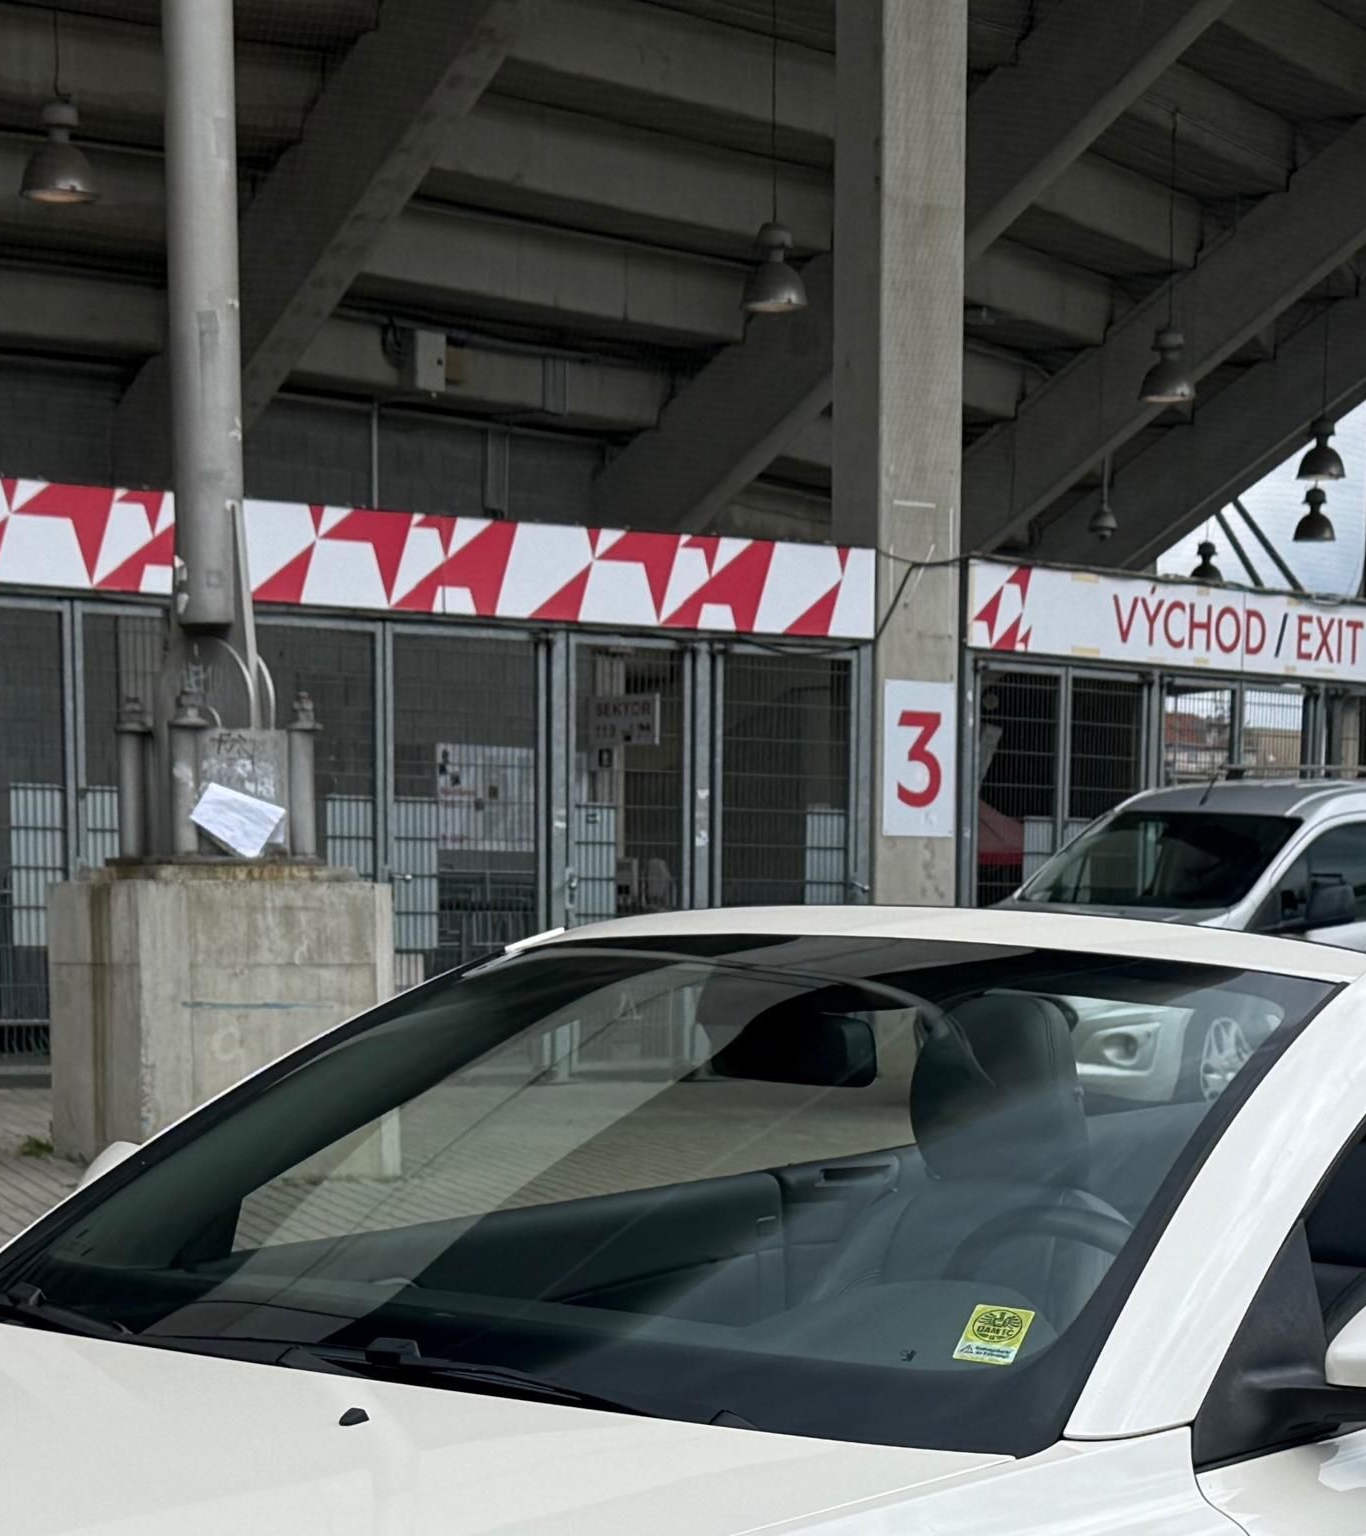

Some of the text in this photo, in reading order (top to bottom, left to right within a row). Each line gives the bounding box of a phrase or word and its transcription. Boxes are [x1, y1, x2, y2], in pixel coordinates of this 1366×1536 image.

[1113, 584, 1365, 665] VÝCHOD / EXIT
[897, 710, 942, 809] 3
